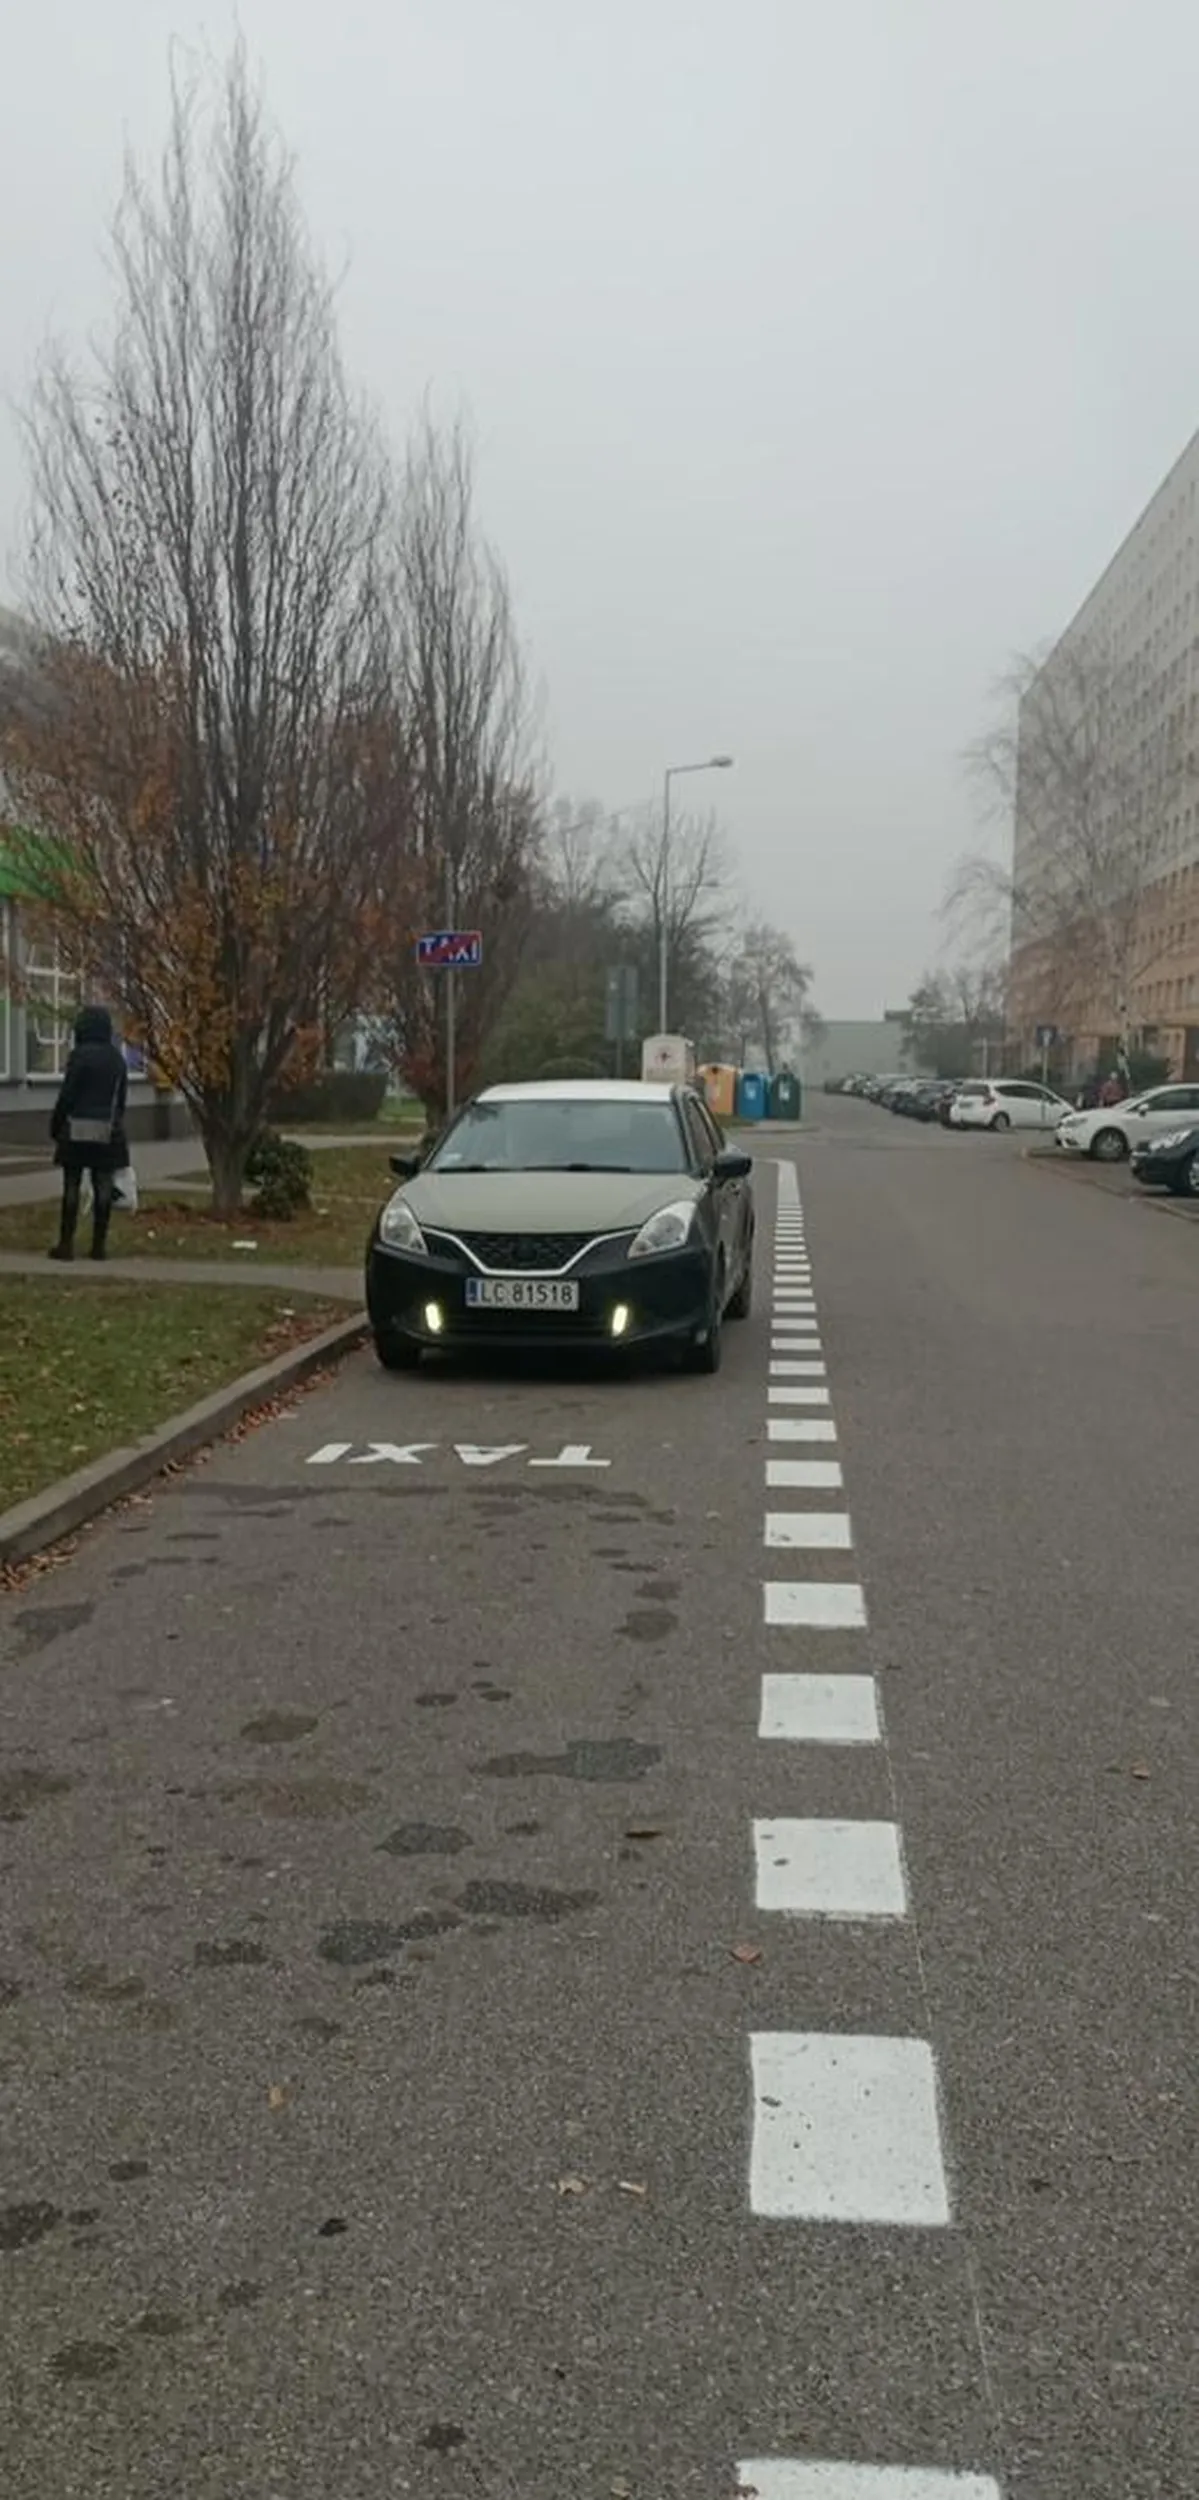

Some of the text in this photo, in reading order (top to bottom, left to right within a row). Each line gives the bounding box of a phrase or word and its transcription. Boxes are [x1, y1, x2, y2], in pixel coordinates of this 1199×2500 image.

[422, 936, 478, 961] TAXI
[481, 1282, 573, 1305] LC 81518
[305, 1443, 611, 1466] TAXI
